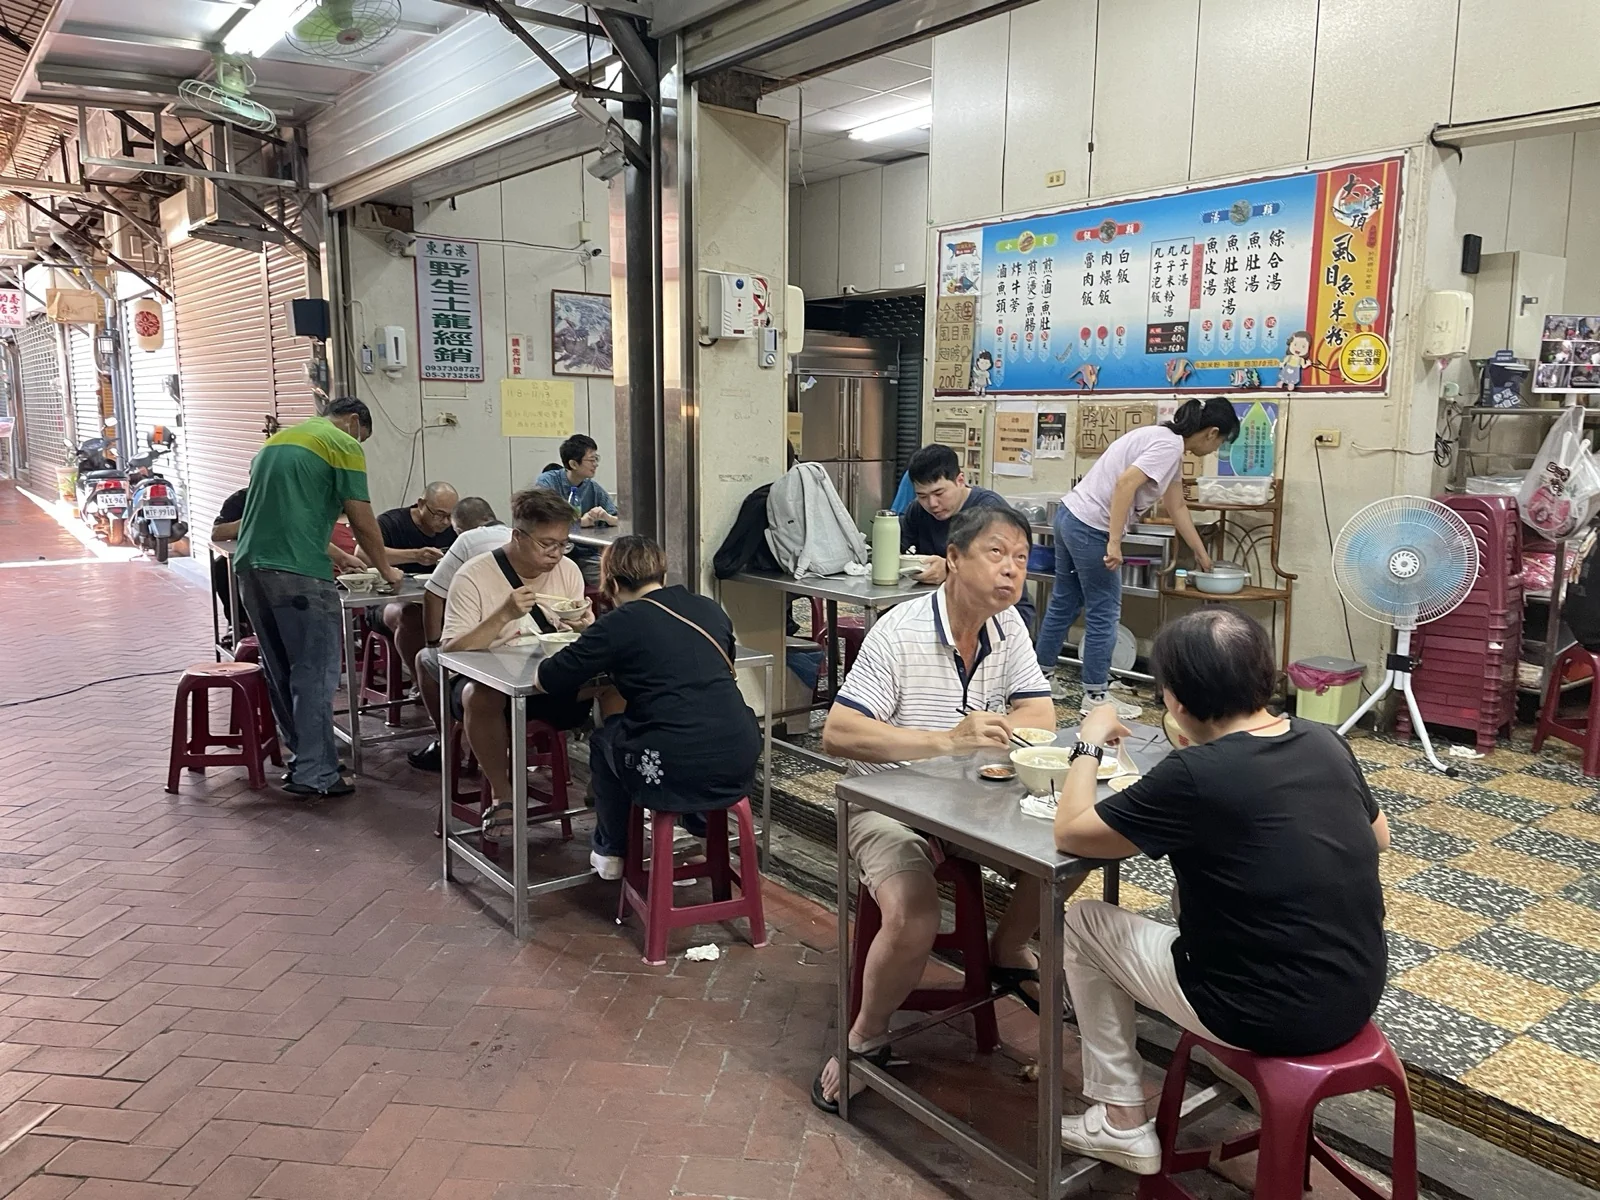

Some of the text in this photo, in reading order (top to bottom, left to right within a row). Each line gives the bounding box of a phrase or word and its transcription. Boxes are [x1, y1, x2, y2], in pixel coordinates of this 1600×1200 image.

[425, 240, 467, 257] 東石港
[1116, 249, 1130, 284] 白飯
[1151, 247, 1164, 304] 丸子泡飯
[1178, 244, 1191, 287] 丸子湯
[1203, 237, 1218, 296] 魚皮湯
[1245, 231, 1261, 293] 魚肚湯
[1266, 229, 1285, 291] 綜合湯
[995, 263, 1007, 314] 滷魚頭
[1009, 261, 1022, 313] 炸牛蒡
[1081, 252, 1094, 306] 魯肉飯
[1098, 250, 1112, 305] 肉燥飯
[1164, 245, 1178, 318] 丸子米粉湯
[1325, 233, 1357, 346] 虱目魚米粉
[429, 260, 473, 363] 野生土龍經銷
[425, 364, 480, 372] 0937308727
[425, 371, 480, 379] 05-3732565
